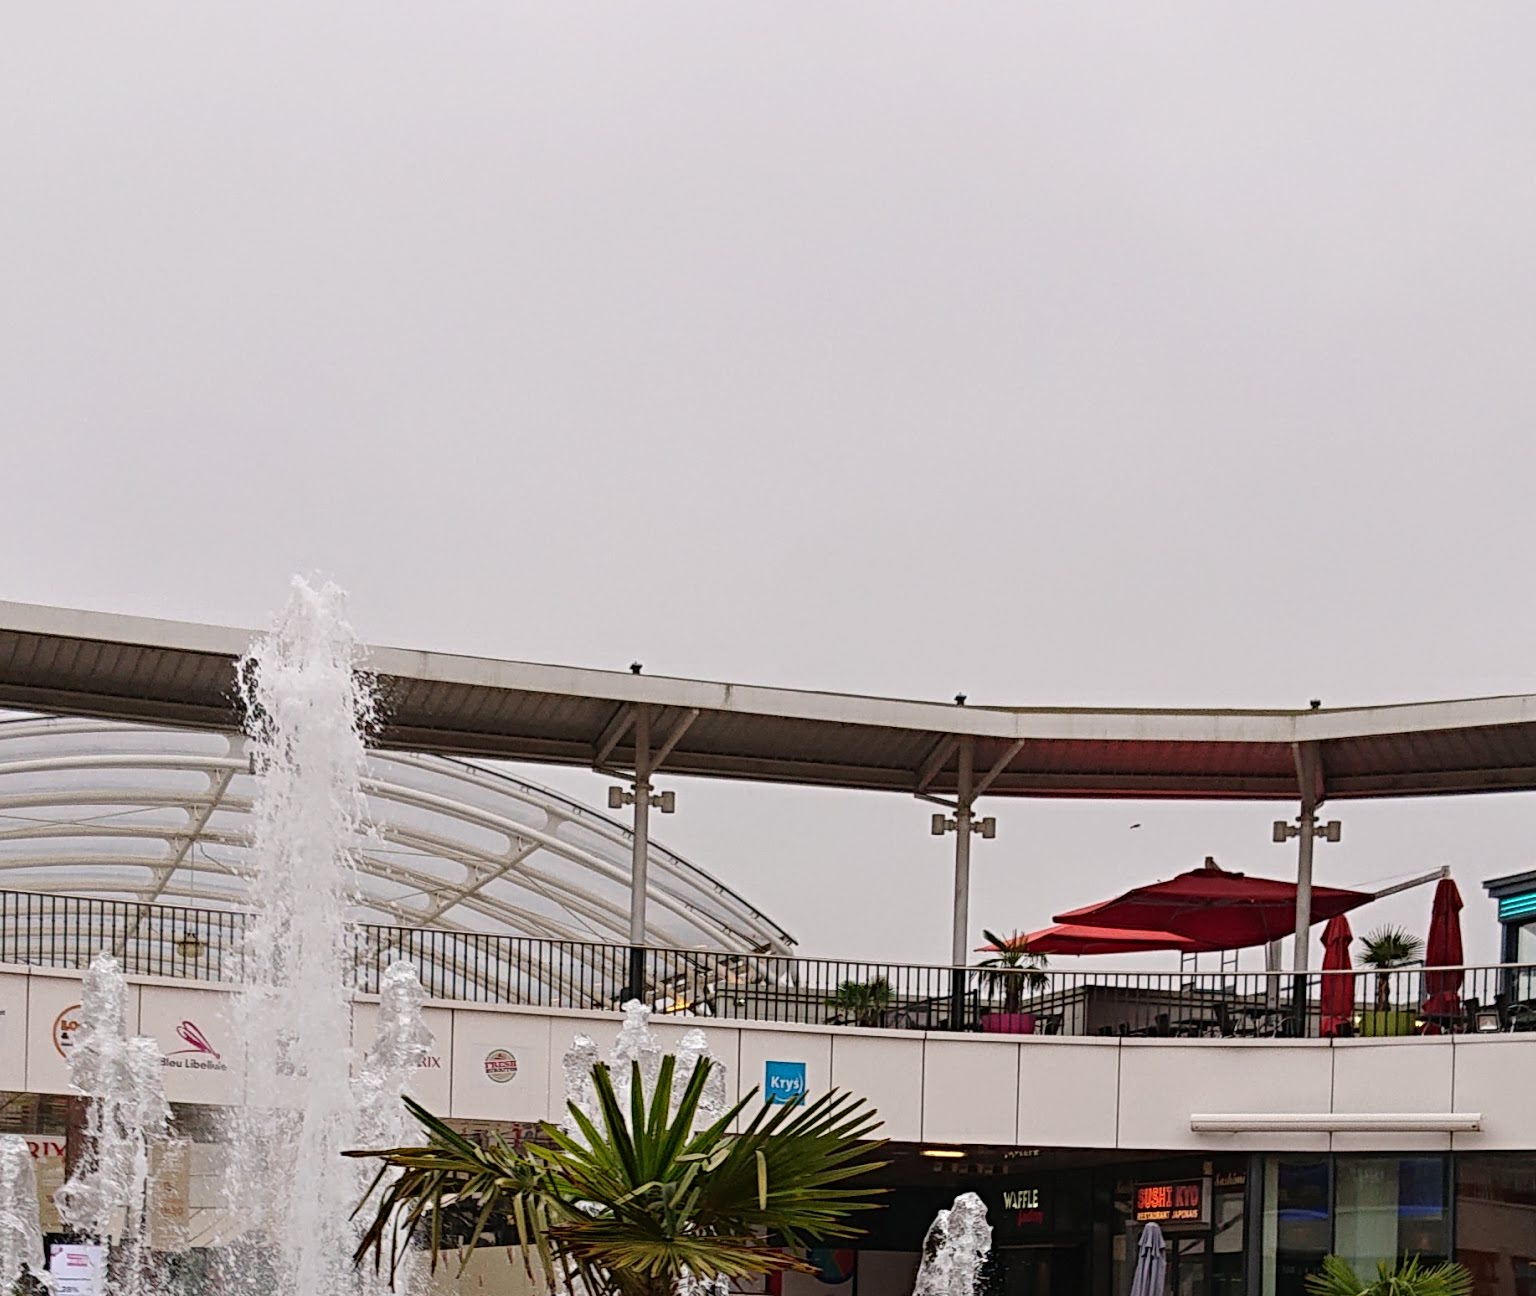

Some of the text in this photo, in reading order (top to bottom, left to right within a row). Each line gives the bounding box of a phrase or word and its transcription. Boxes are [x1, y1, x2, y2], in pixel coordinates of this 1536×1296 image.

[770, 1075, 800, 1092] Krys
[1003, 1188, 1039, 1210] WAFFLE
[1137, 1184, 1199, 1209] SUSHI KYO
